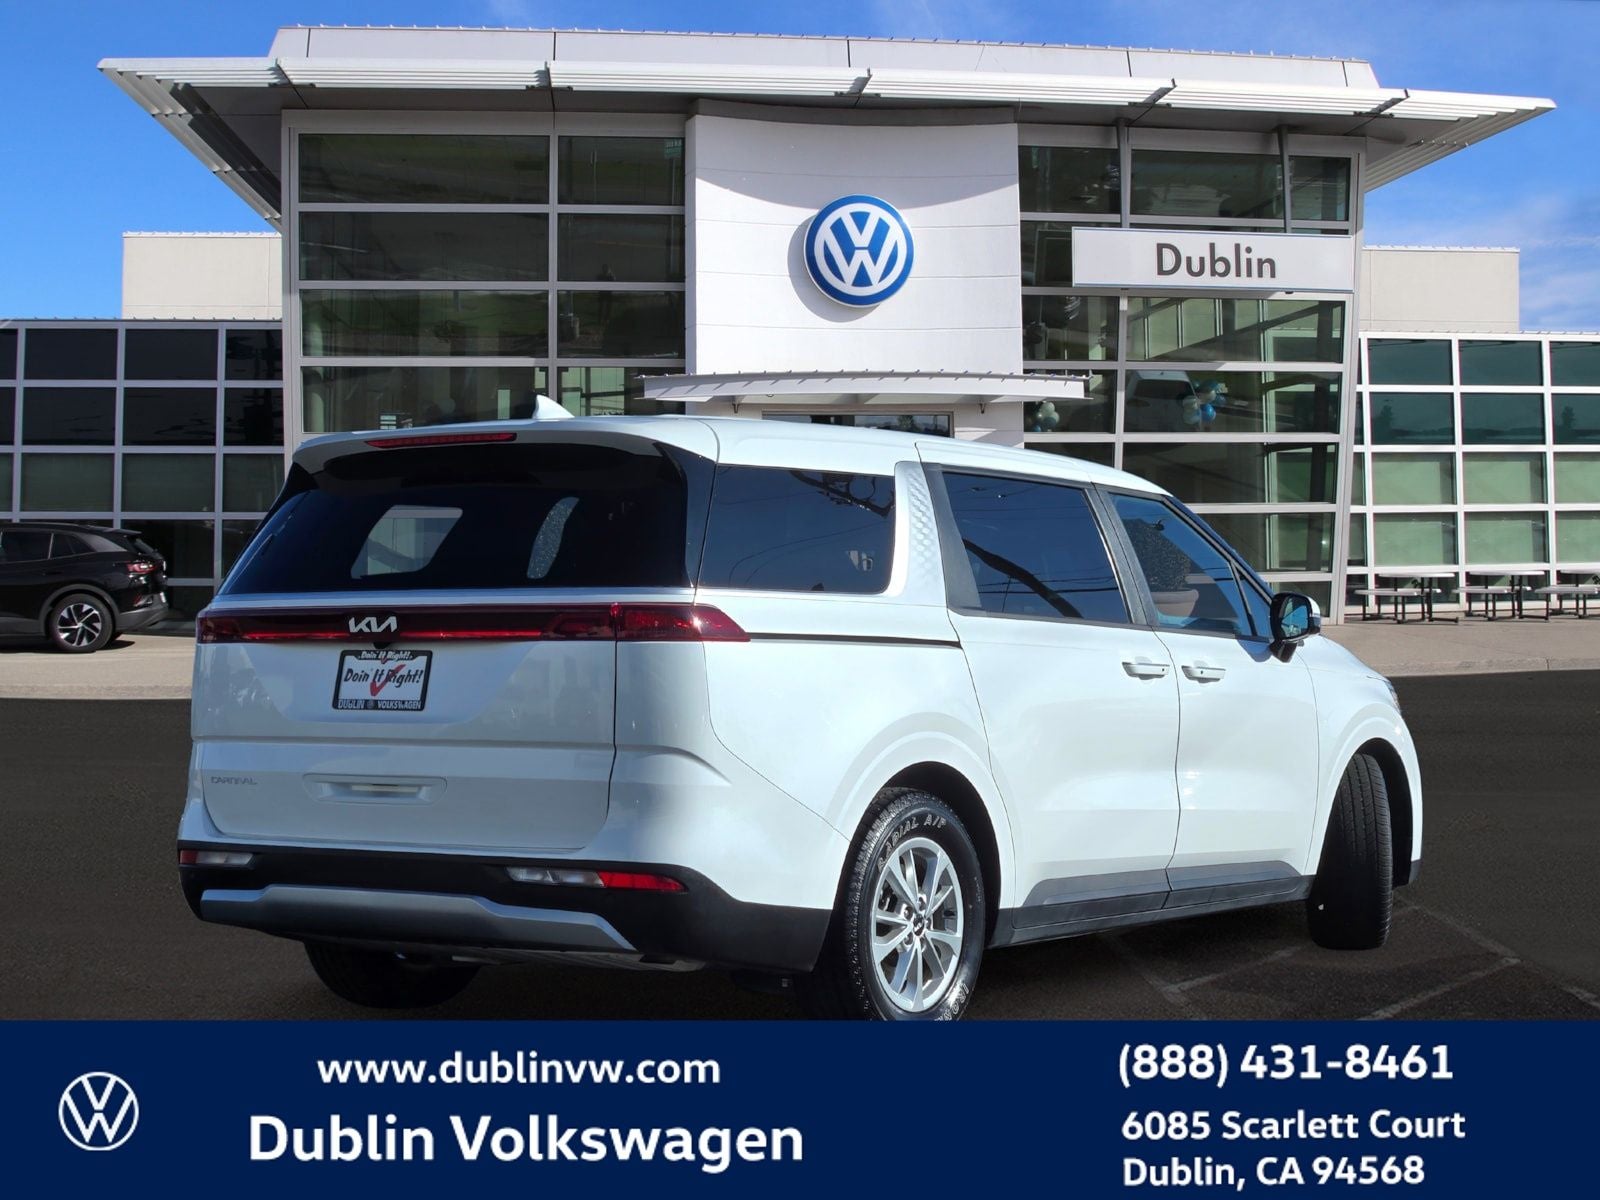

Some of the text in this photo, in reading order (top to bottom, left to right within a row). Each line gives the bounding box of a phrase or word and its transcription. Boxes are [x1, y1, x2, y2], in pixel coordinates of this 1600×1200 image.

[1156, 242, 1276, 279] Dublin
[348, 615, 398, 633] KIA
[373, 668, 385, 683] It
[385, 668, 424, 689] Right!
[377, 700, 422, 710] VOLKSWAGEN
